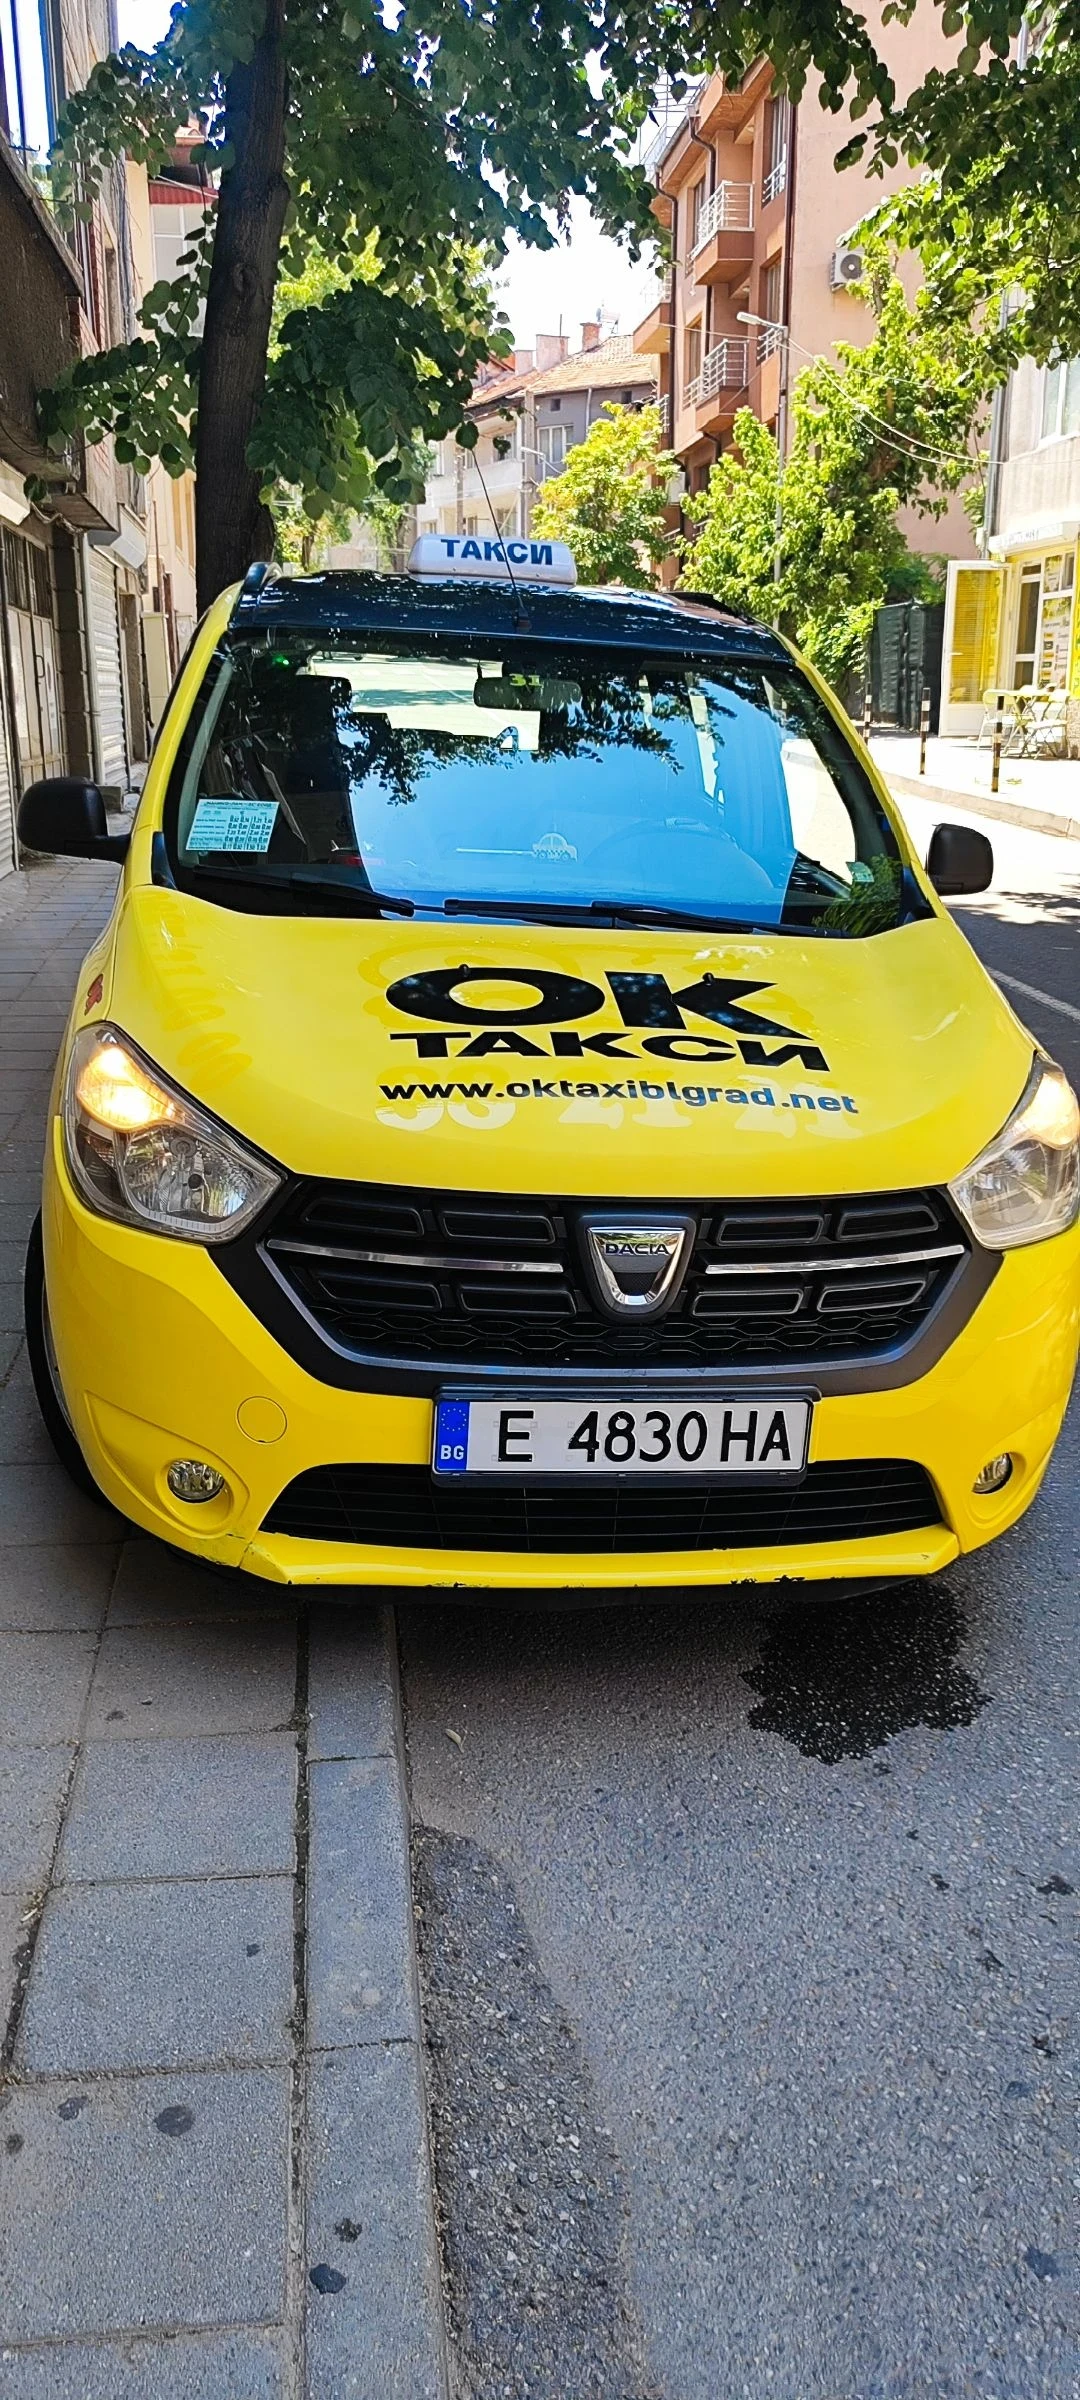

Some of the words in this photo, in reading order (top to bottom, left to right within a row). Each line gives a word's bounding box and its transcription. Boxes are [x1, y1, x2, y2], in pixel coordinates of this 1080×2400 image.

[441, 539, 553, 566] ТАКСИ
[389, 1031, 830, 1072] ТАКСИ
[379, 1078, 859, 1115] www.oktaxiblgrad.net
[605, 1243, 669, 1256] DACIA
[440, 1444, 464, 1461] BG
[498, 1410, 534, 1462] E
[567, 1410, 708, 1463] 4830
[719, 1410, 792, 1462] HA
